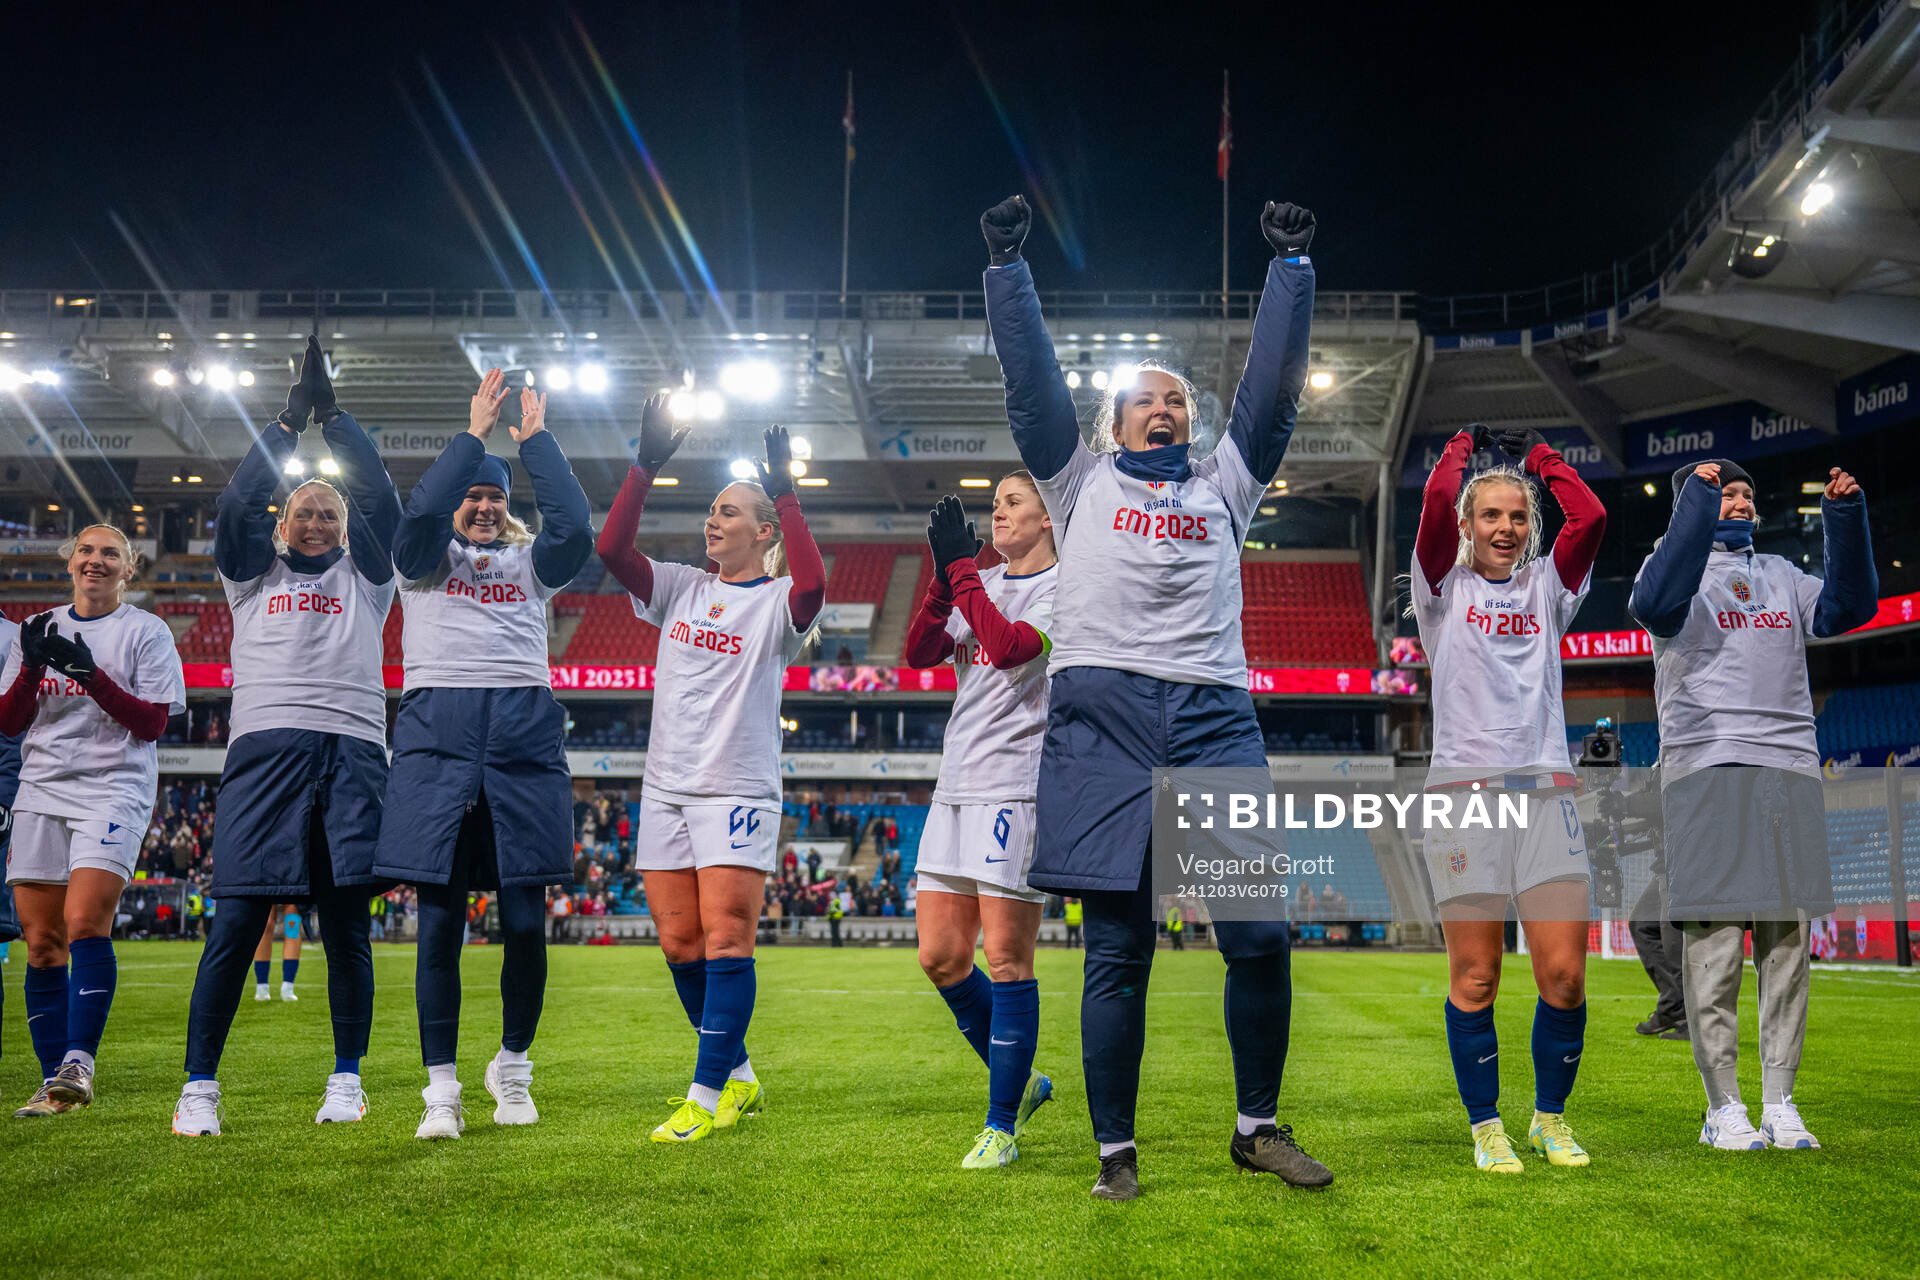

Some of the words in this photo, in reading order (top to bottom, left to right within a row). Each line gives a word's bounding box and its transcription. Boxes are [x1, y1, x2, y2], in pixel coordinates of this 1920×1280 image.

[1460, 336, 1496, 348] bama
[1854, 382, 1908, 415] bama
[1751, 415, 1811, 441] bam
[60, 431, 133, 449] telenor
[914, 433, 986, 453] telenor
[1289, 437, 1353, 454] elenor
[1647, 430, 1715, 457] bama
[1154, 514, 1208, 540] 2025
[298, 592, 343, 615] 2025
[480, 583, 527, 604] 2025
[1495, 600, 1512, 609] ska
[1497, 613, 1541, 636] 2025
[1749, 611, 1793, 629] 2025
[693, 628, 744, 656] 2025
[1567, 633, 1589, 656] Vi
[1594, 631, 1638, 654] skal
[584, 668, 635, 688] 2025
[158, 754, 190, 766] lenor
